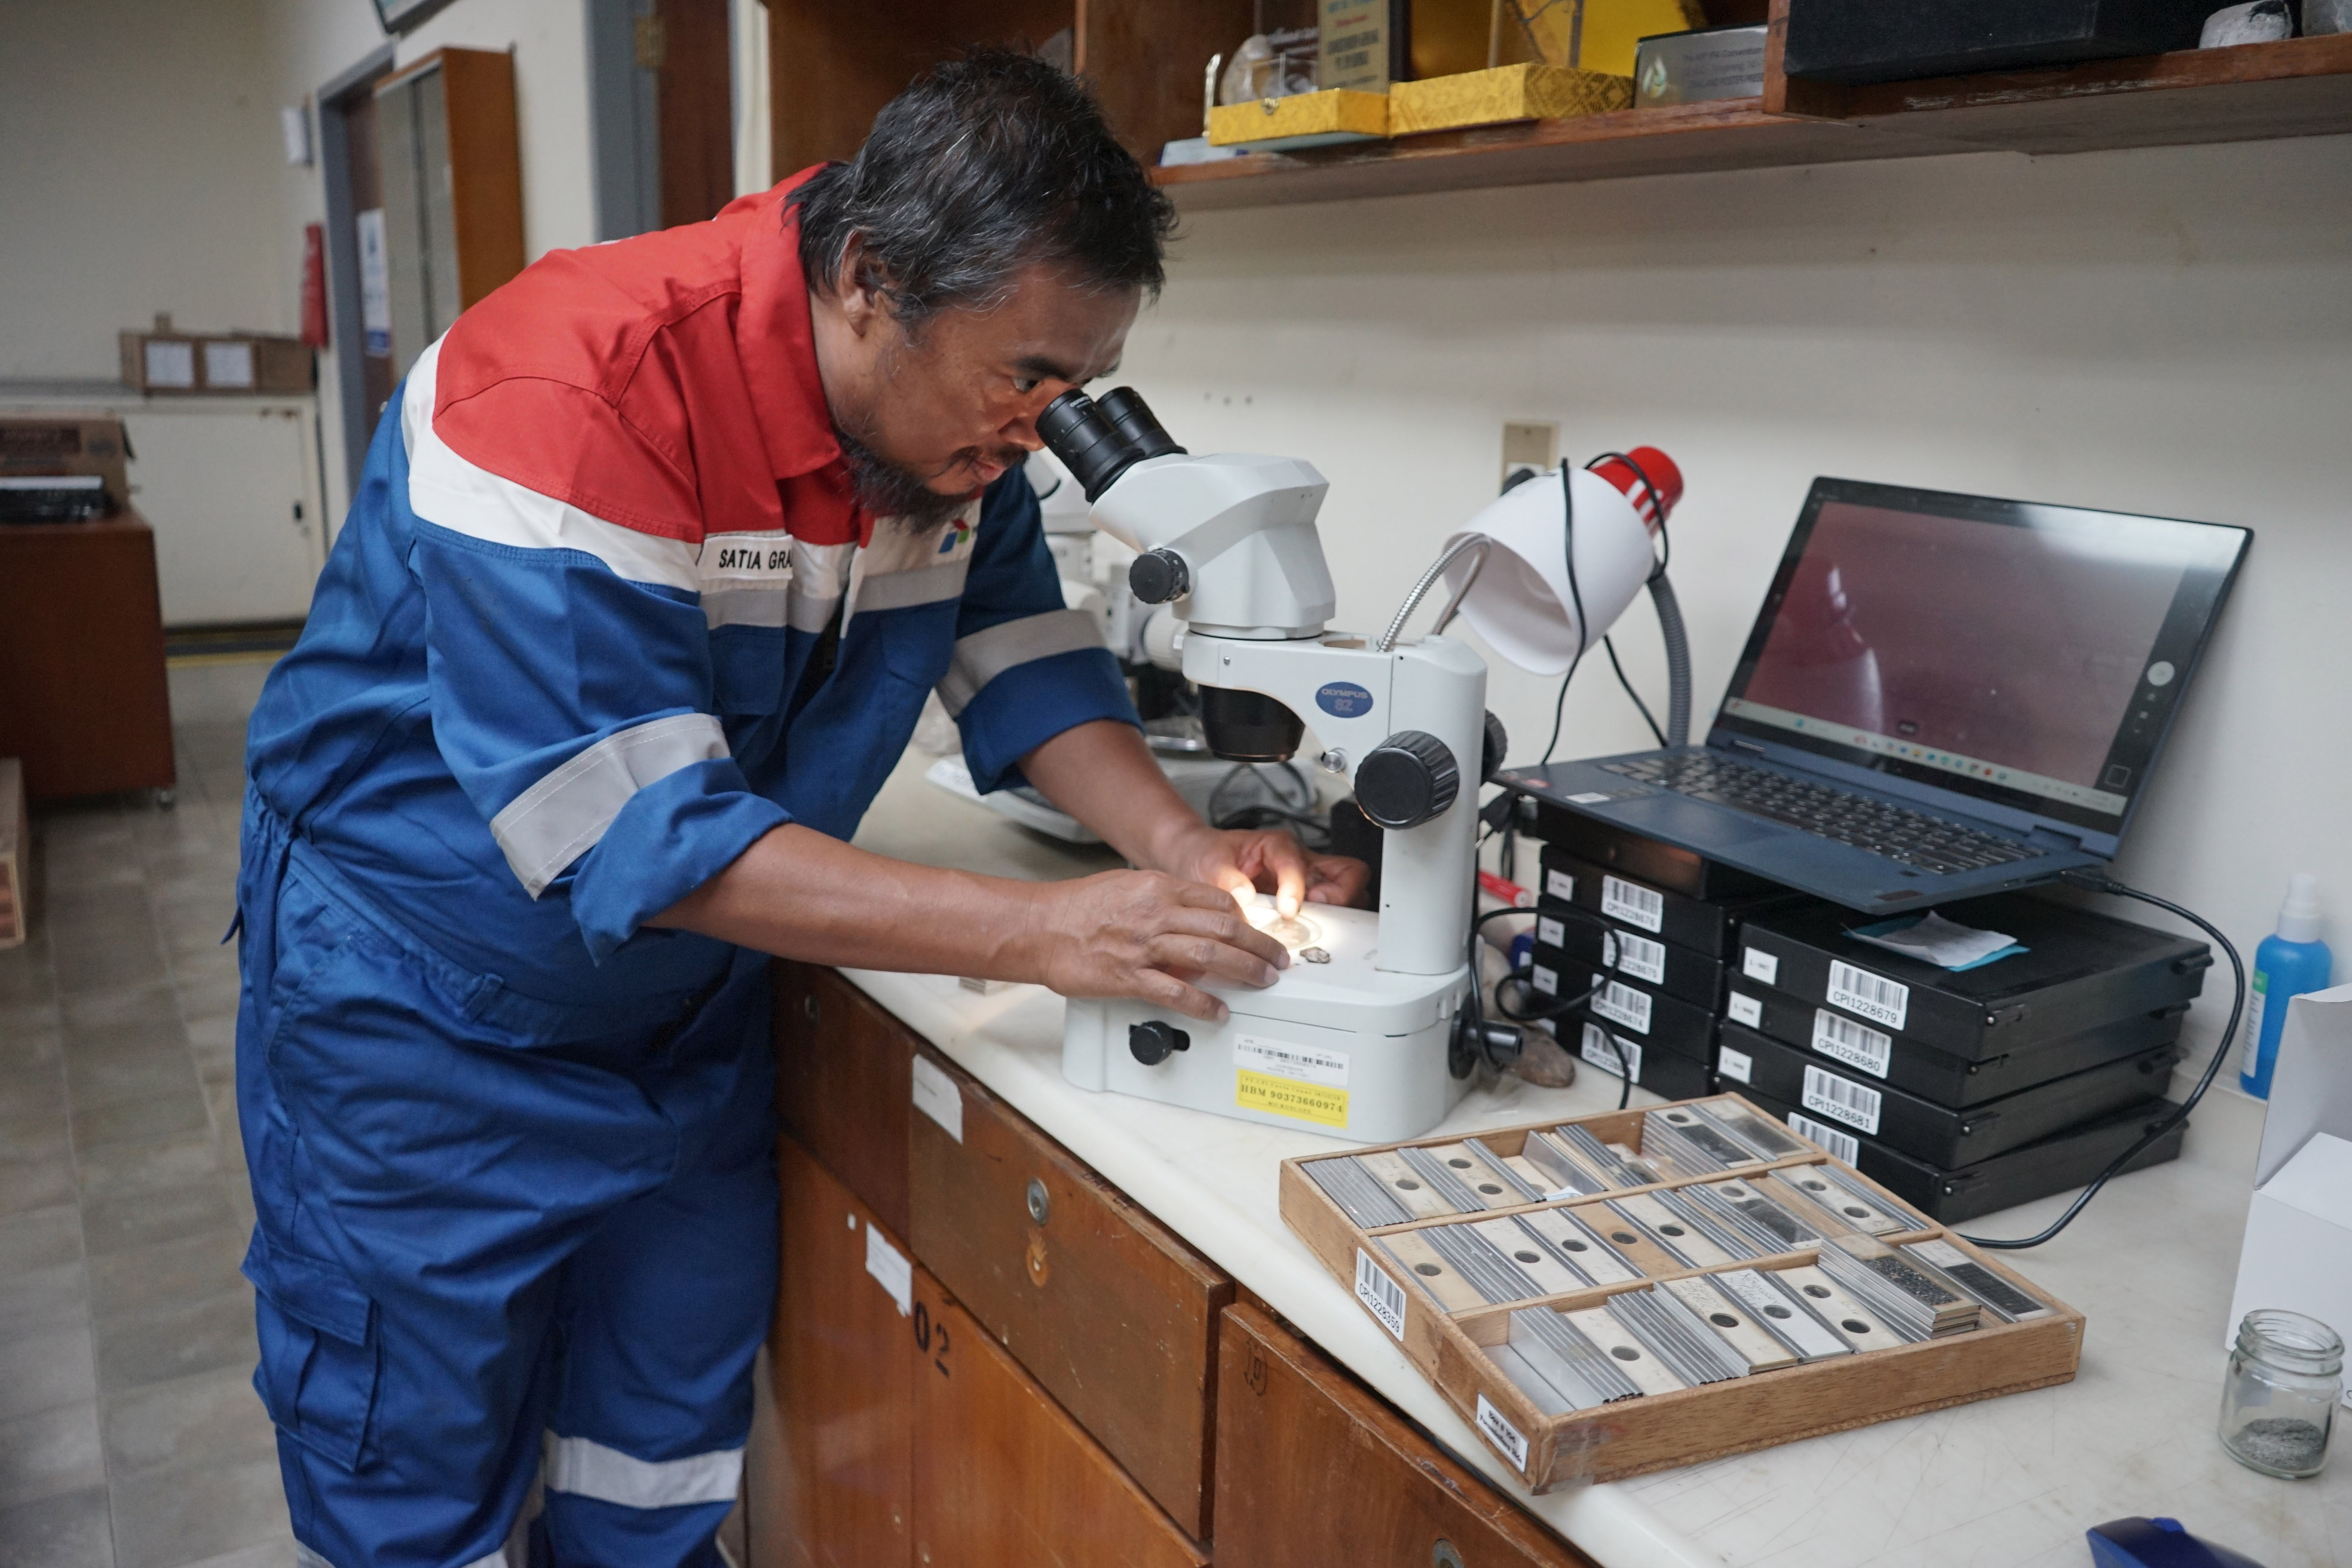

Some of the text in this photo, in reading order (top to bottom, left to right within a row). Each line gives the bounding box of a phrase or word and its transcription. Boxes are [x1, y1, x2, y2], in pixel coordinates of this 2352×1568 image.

[719, 549, 761, 569] SATIA
[1321, 688, 1368, 699] OLYMPUS
[1833, 991, 1897, 1024] CPI1228679
[1818, 1039, 1881, 1071] CPI1228680
[1241, 1084, 1266, 1097] HBM
[1270, 1091, 1343, 1112] 90373660974
[1808, 1095, 1870, 1128] CPI1228681
[1359, 1283, 1399, 1333] CPI1228359
